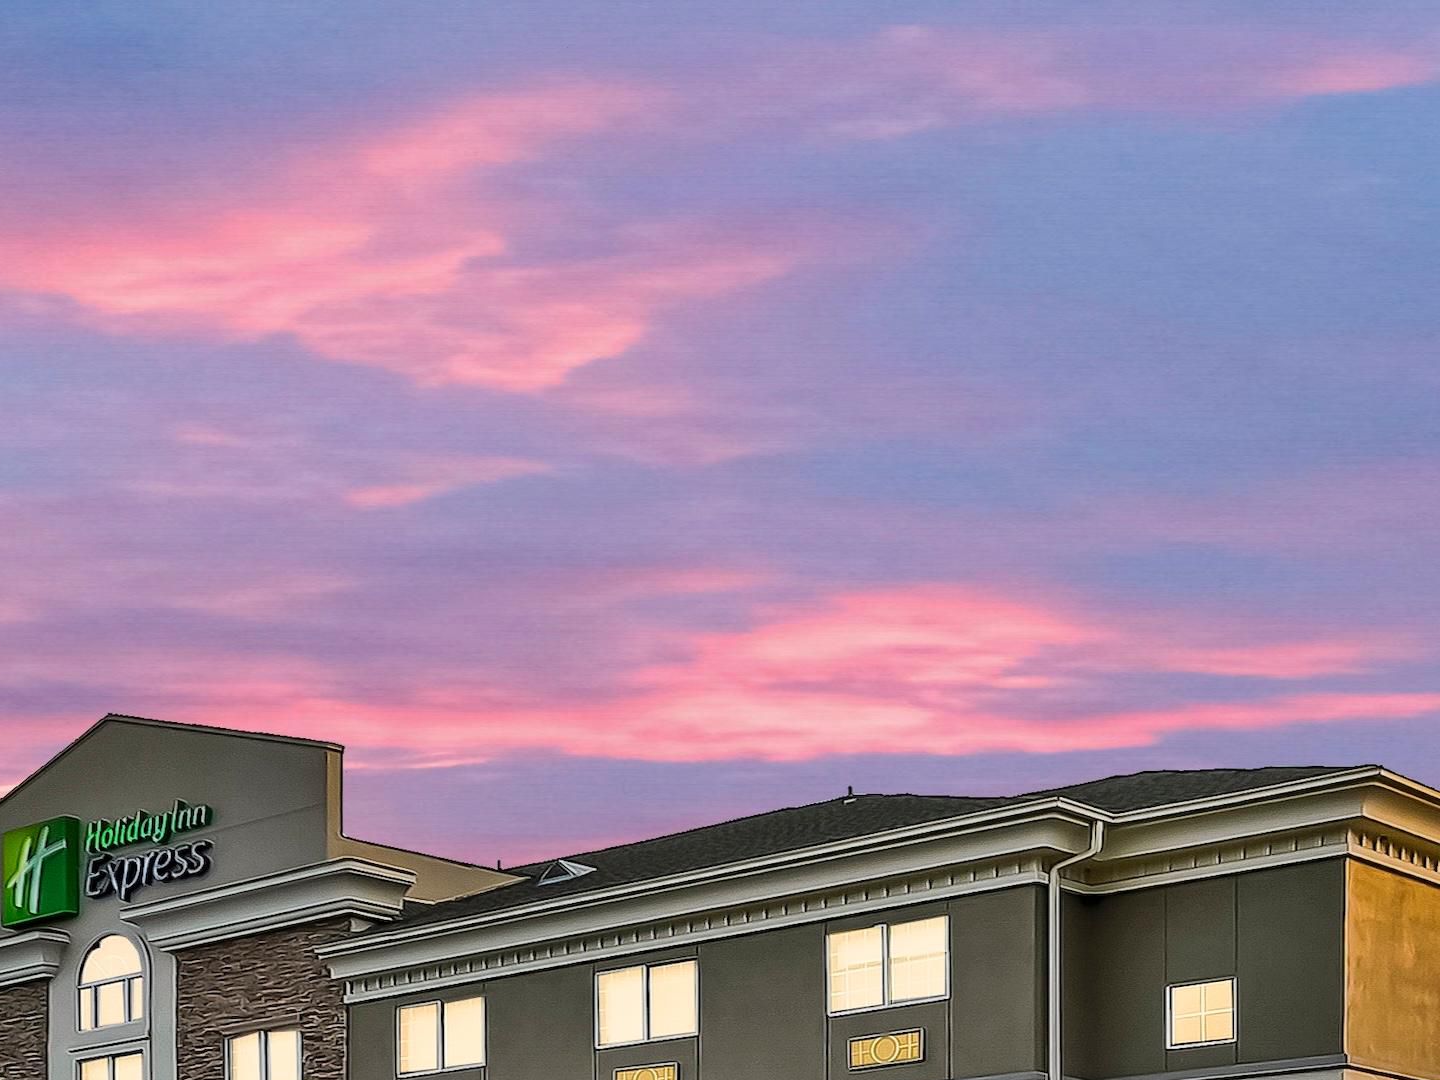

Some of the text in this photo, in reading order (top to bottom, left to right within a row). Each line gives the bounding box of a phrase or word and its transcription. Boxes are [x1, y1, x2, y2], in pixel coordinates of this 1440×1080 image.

[85, 799, 212, 854] Holiday Inn
[85, 840, 214, 902] Express
